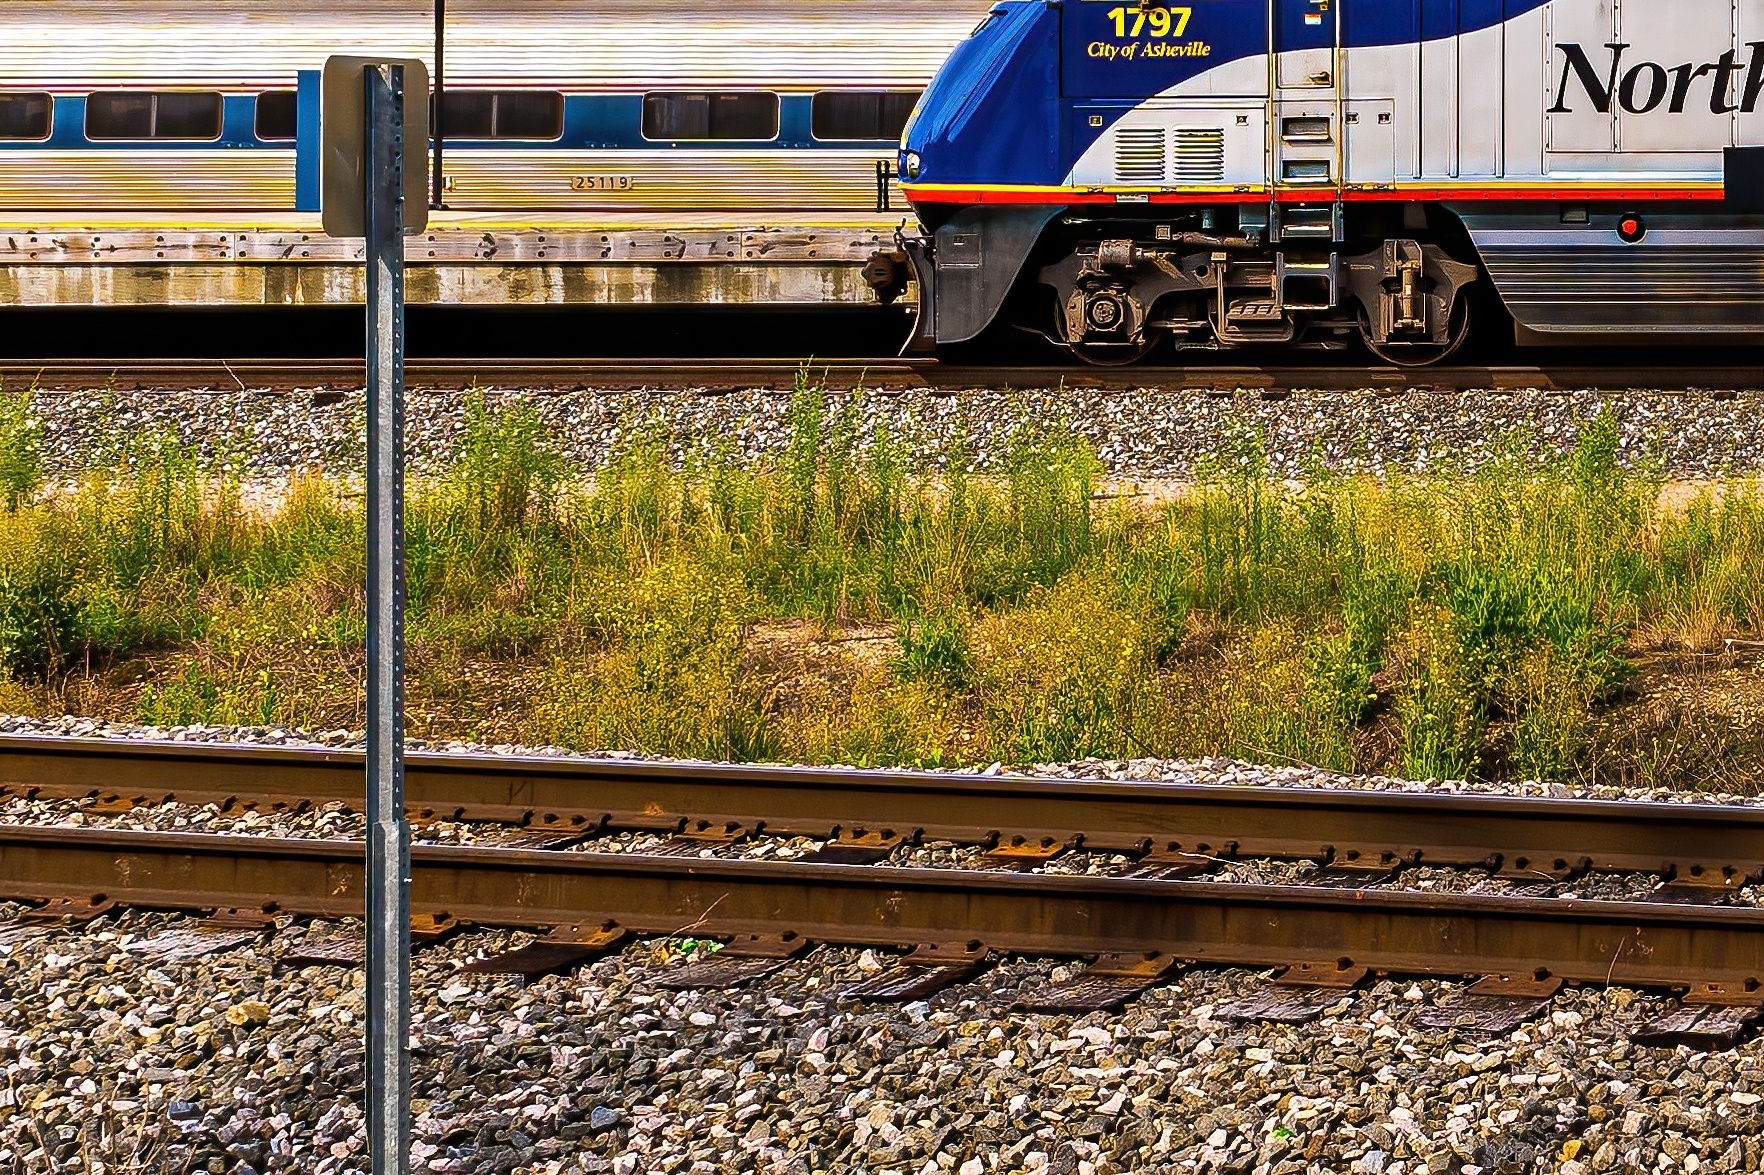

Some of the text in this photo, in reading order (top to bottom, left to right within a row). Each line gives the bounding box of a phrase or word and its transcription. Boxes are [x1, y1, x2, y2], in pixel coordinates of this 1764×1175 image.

[1107, 7, 1192, 37] 1797
[1088, 41, 1211, 61] City of Asheville
[576, 176, 628, 188] 25119
